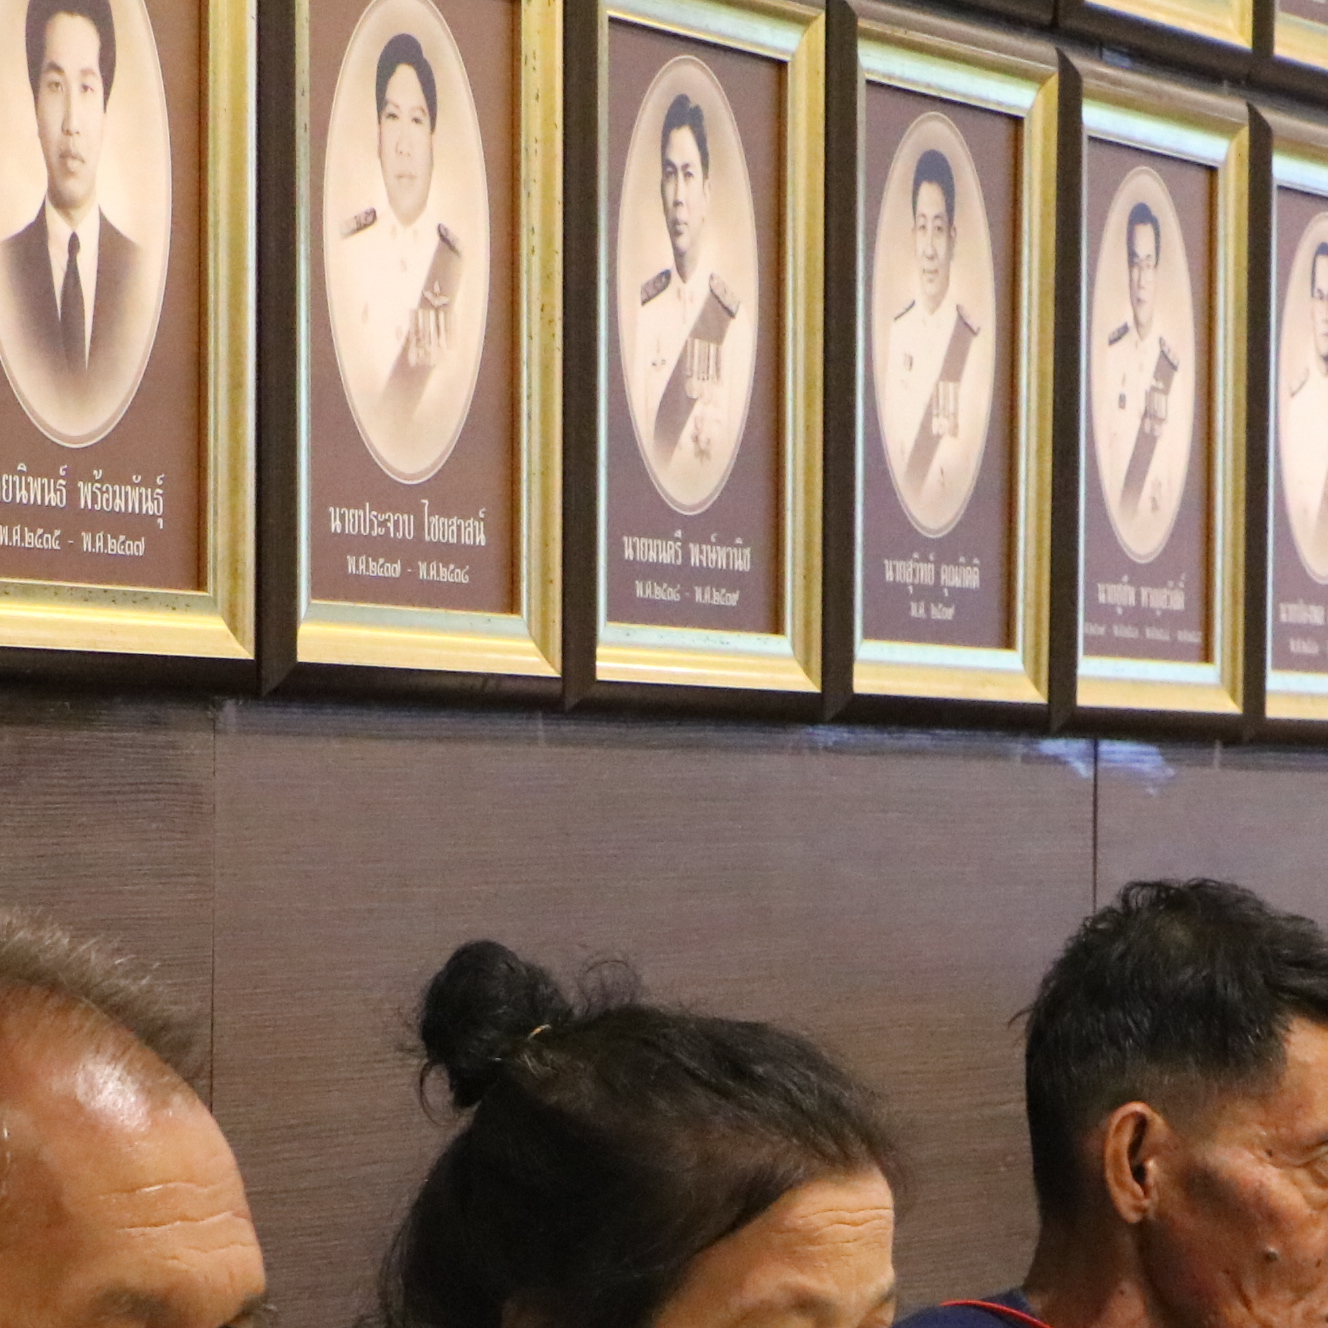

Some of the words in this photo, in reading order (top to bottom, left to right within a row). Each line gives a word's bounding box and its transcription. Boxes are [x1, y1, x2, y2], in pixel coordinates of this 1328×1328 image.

[78, 469, 164, 529] พร้อมพันธุ์
[329, 502, 414, 539] นายประจวบ
[82, 531, 145, 556] พ.ศ.๒๕๓๗
